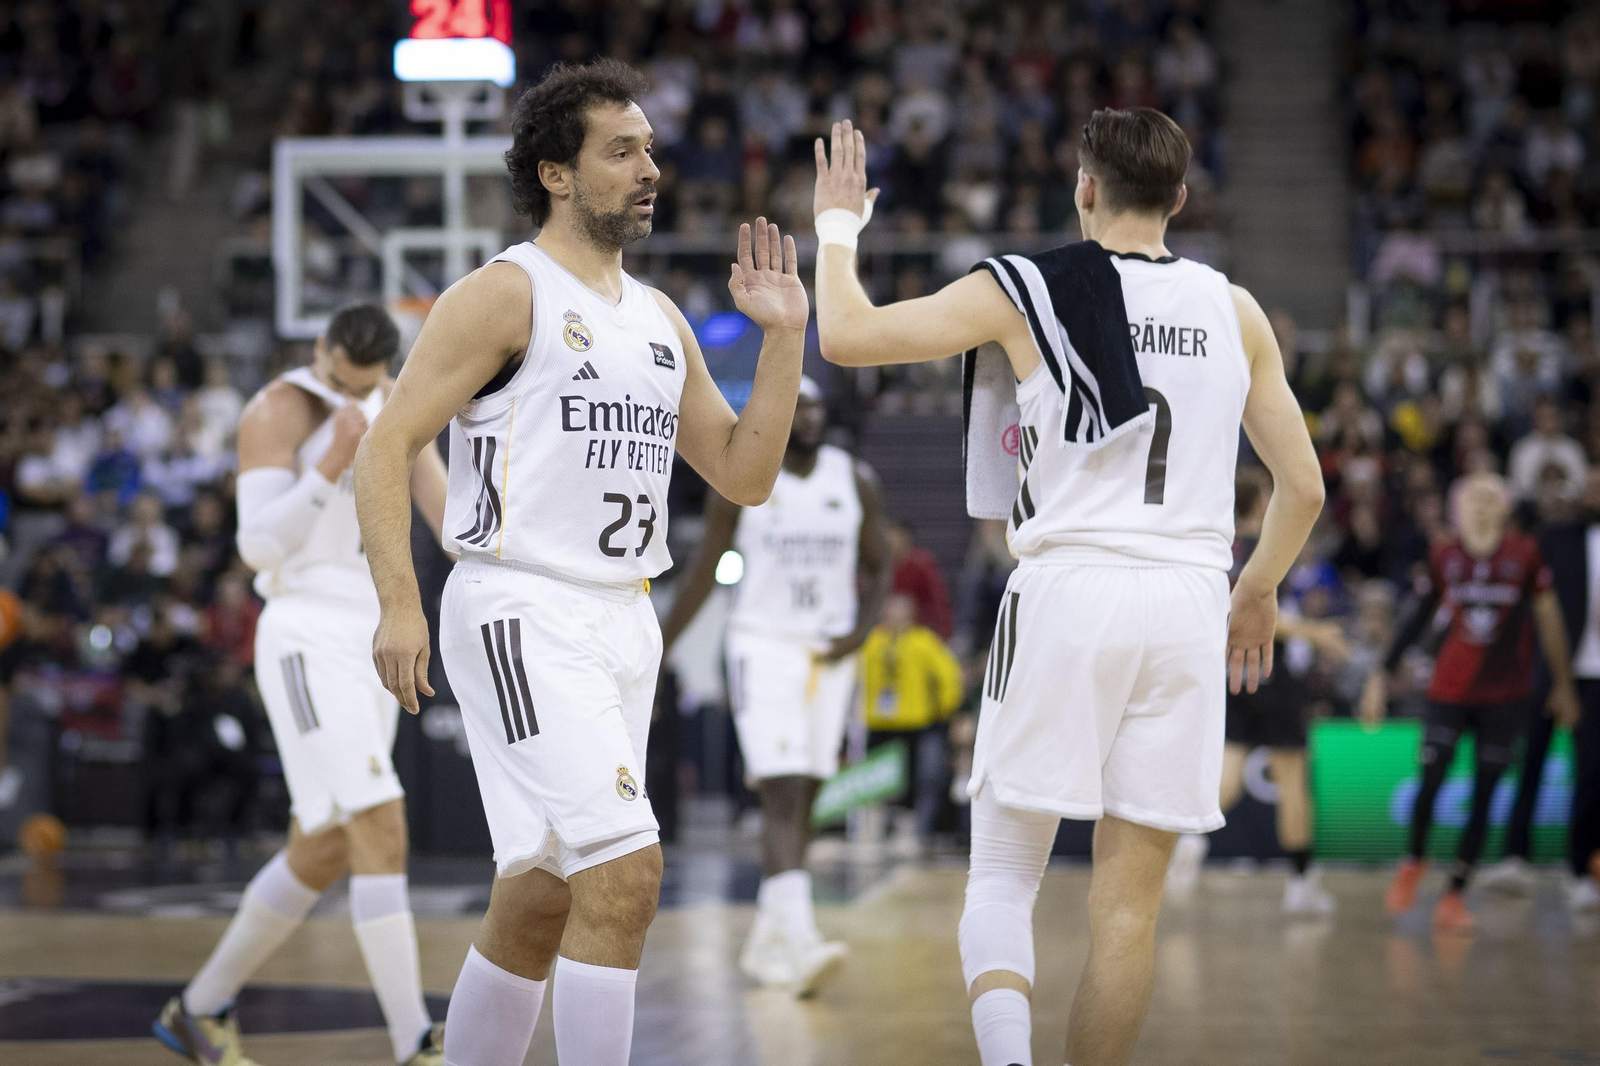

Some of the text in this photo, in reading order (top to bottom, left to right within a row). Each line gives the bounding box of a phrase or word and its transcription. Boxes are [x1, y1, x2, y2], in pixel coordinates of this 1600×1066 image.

[559, 394, 679, 441] Emirates
[585, 439, 669, 476] FLY BETTER
[599, 492, 657, 558] 23
